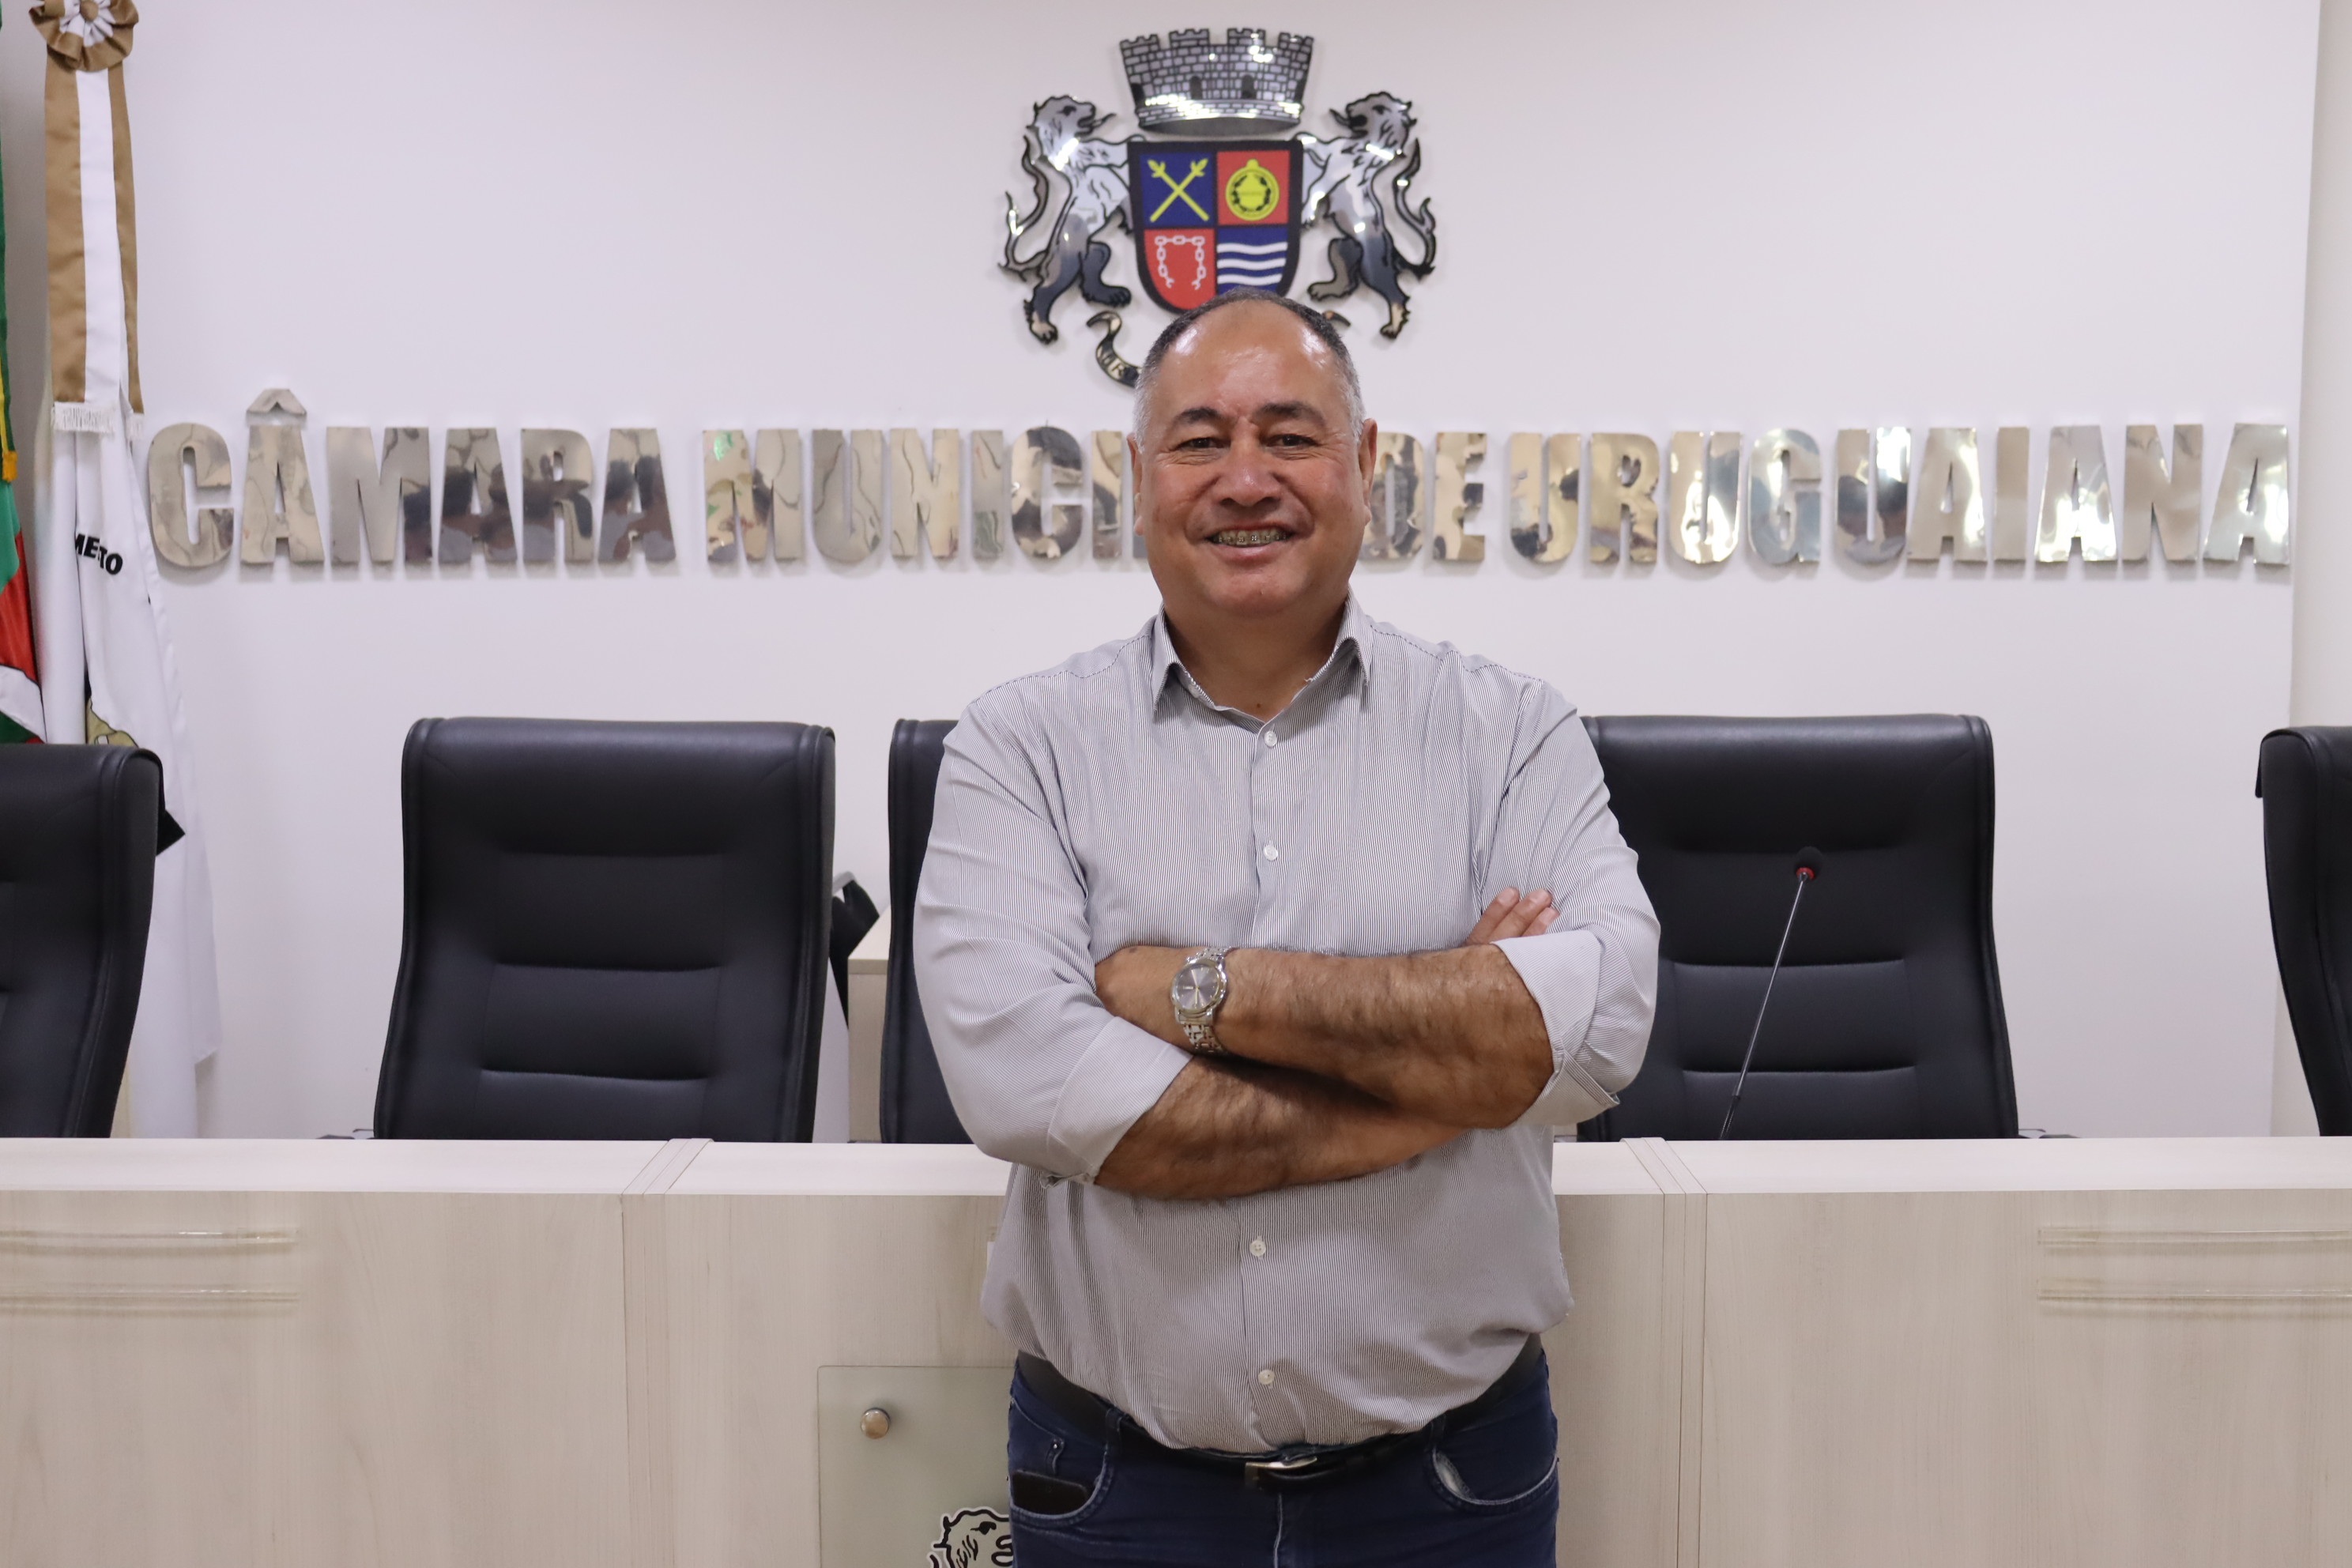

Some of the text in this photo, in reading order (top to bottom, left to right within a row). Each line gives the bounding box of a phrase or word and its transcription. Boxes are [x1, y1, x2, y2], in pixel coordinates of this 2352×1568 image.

[148, 388, 2290, 567] CÂMARA MUNICI DE URUGUAIANA
